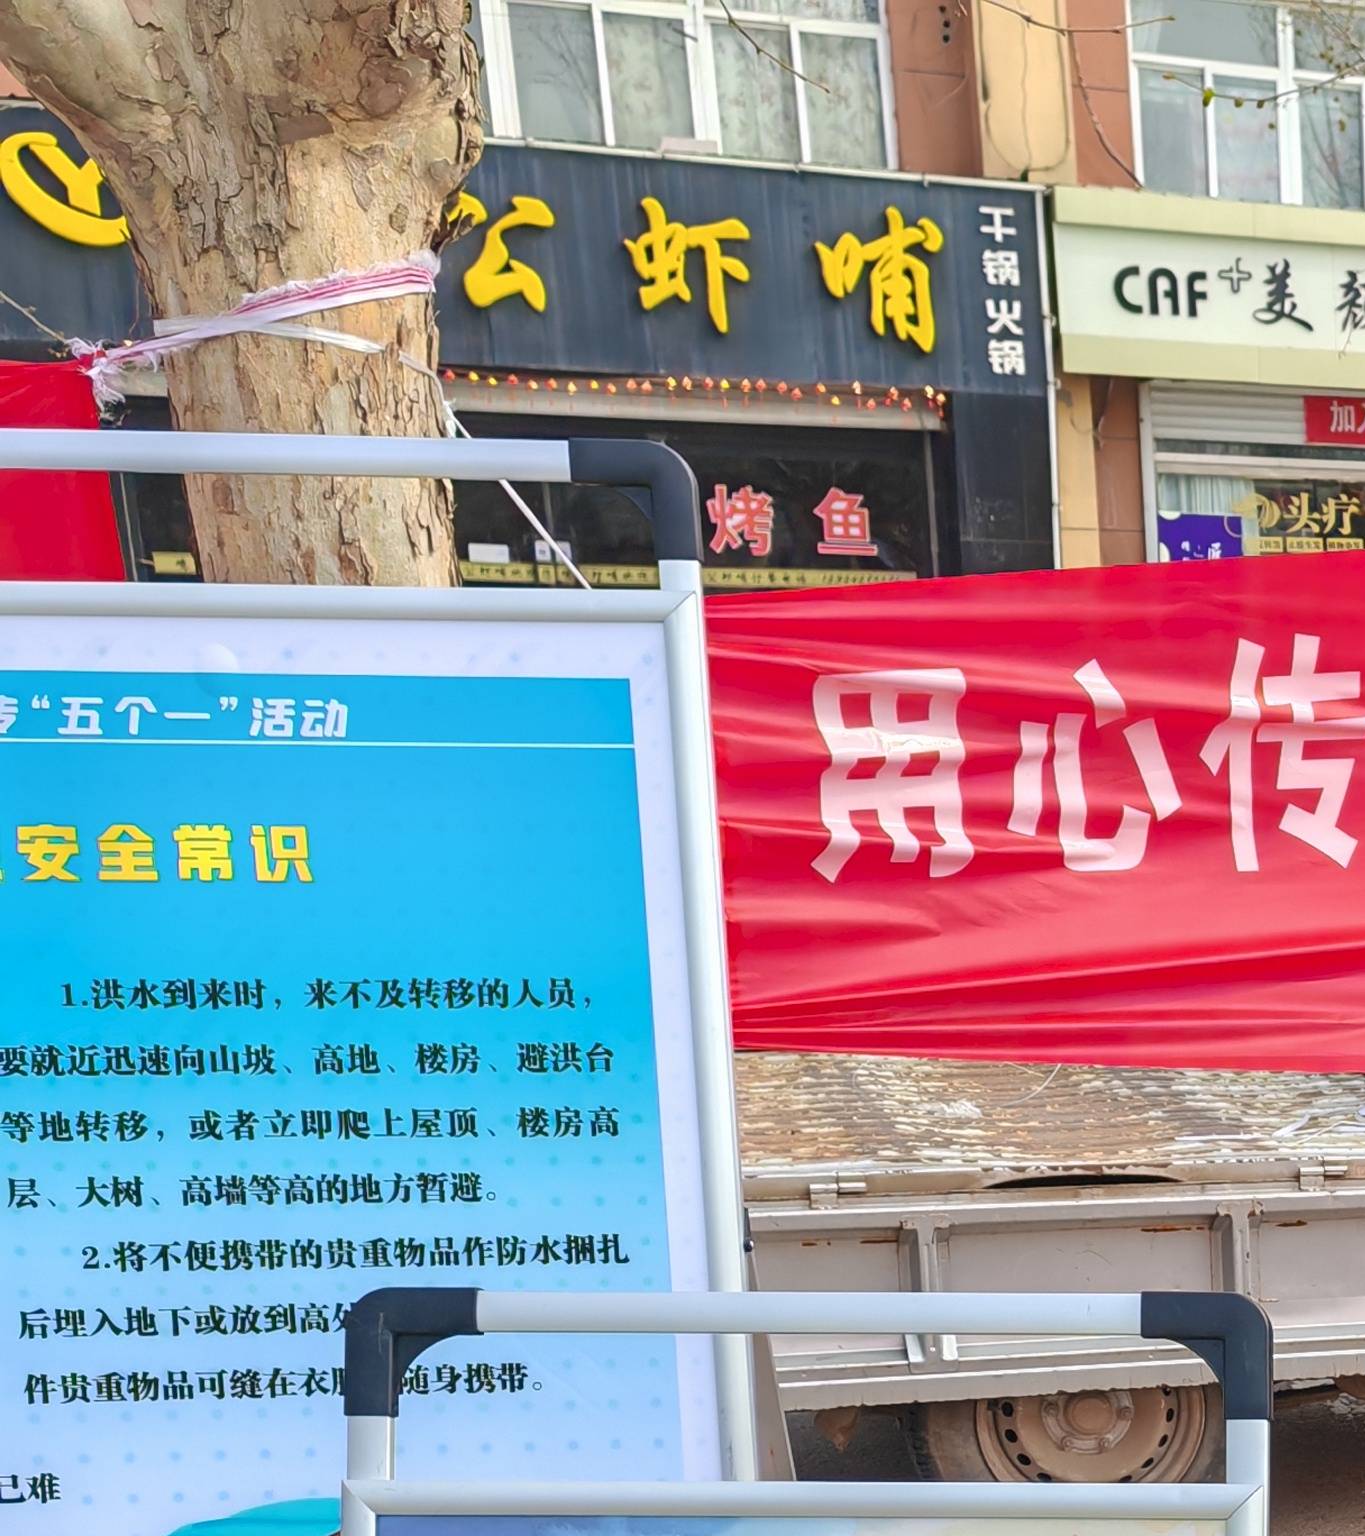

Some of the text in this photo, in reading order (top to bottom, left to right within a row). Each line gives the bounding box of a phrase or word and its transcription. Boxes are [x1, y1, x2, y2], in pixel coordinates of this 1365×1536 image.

[979, 205, 1027, 376] 干锅火锅
[708, 482, 878, 558] 烤鱼
